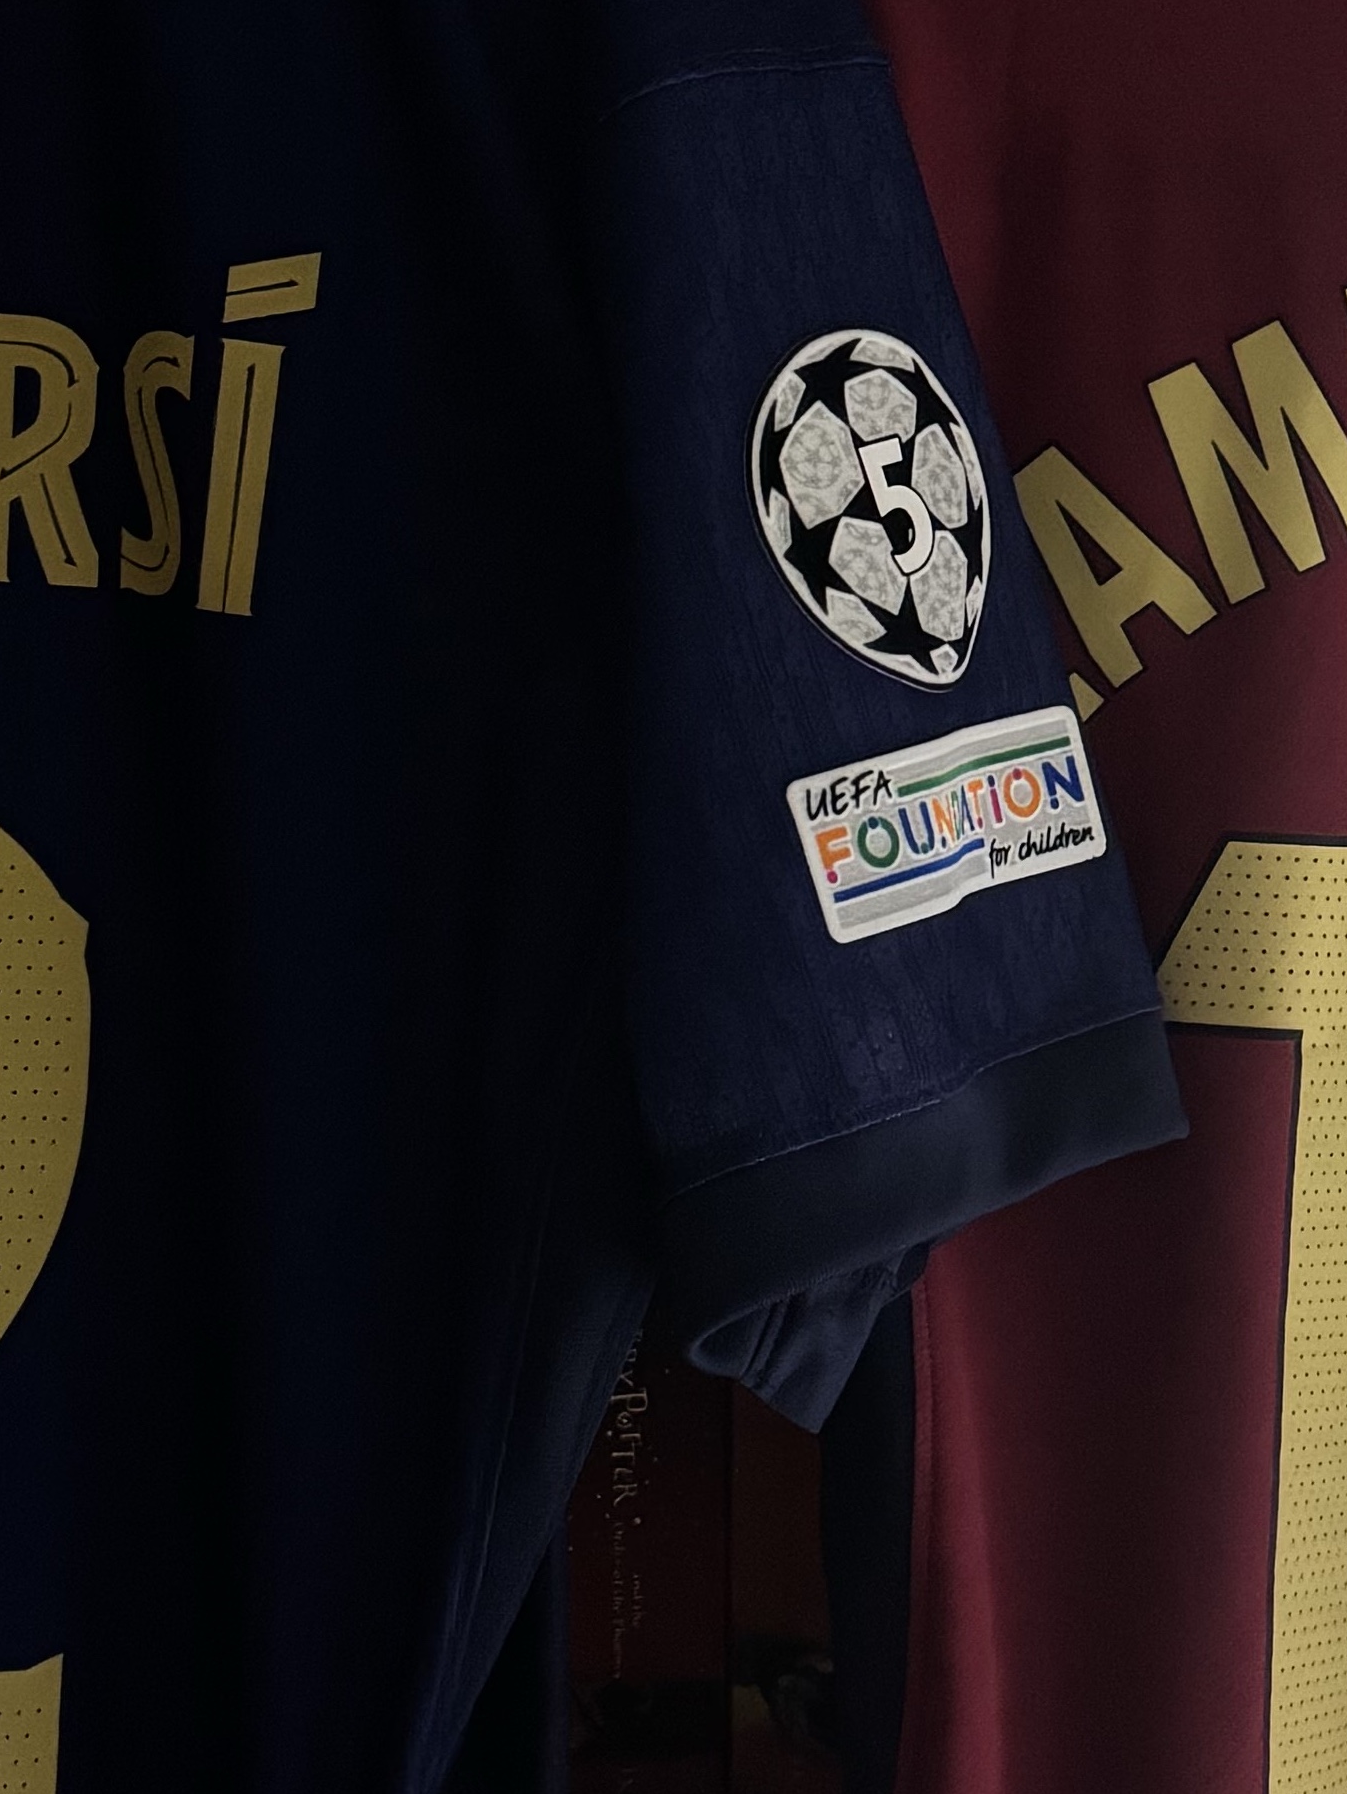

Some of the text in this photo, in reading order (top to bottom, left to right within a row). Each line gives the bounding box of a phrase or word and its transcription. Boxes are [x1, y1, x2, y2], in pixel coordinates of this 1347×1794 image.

[858, 436, 934, 576] 5
[805, 769, 893, 822] UEFA
[989, 822, 1096, 879] for children
